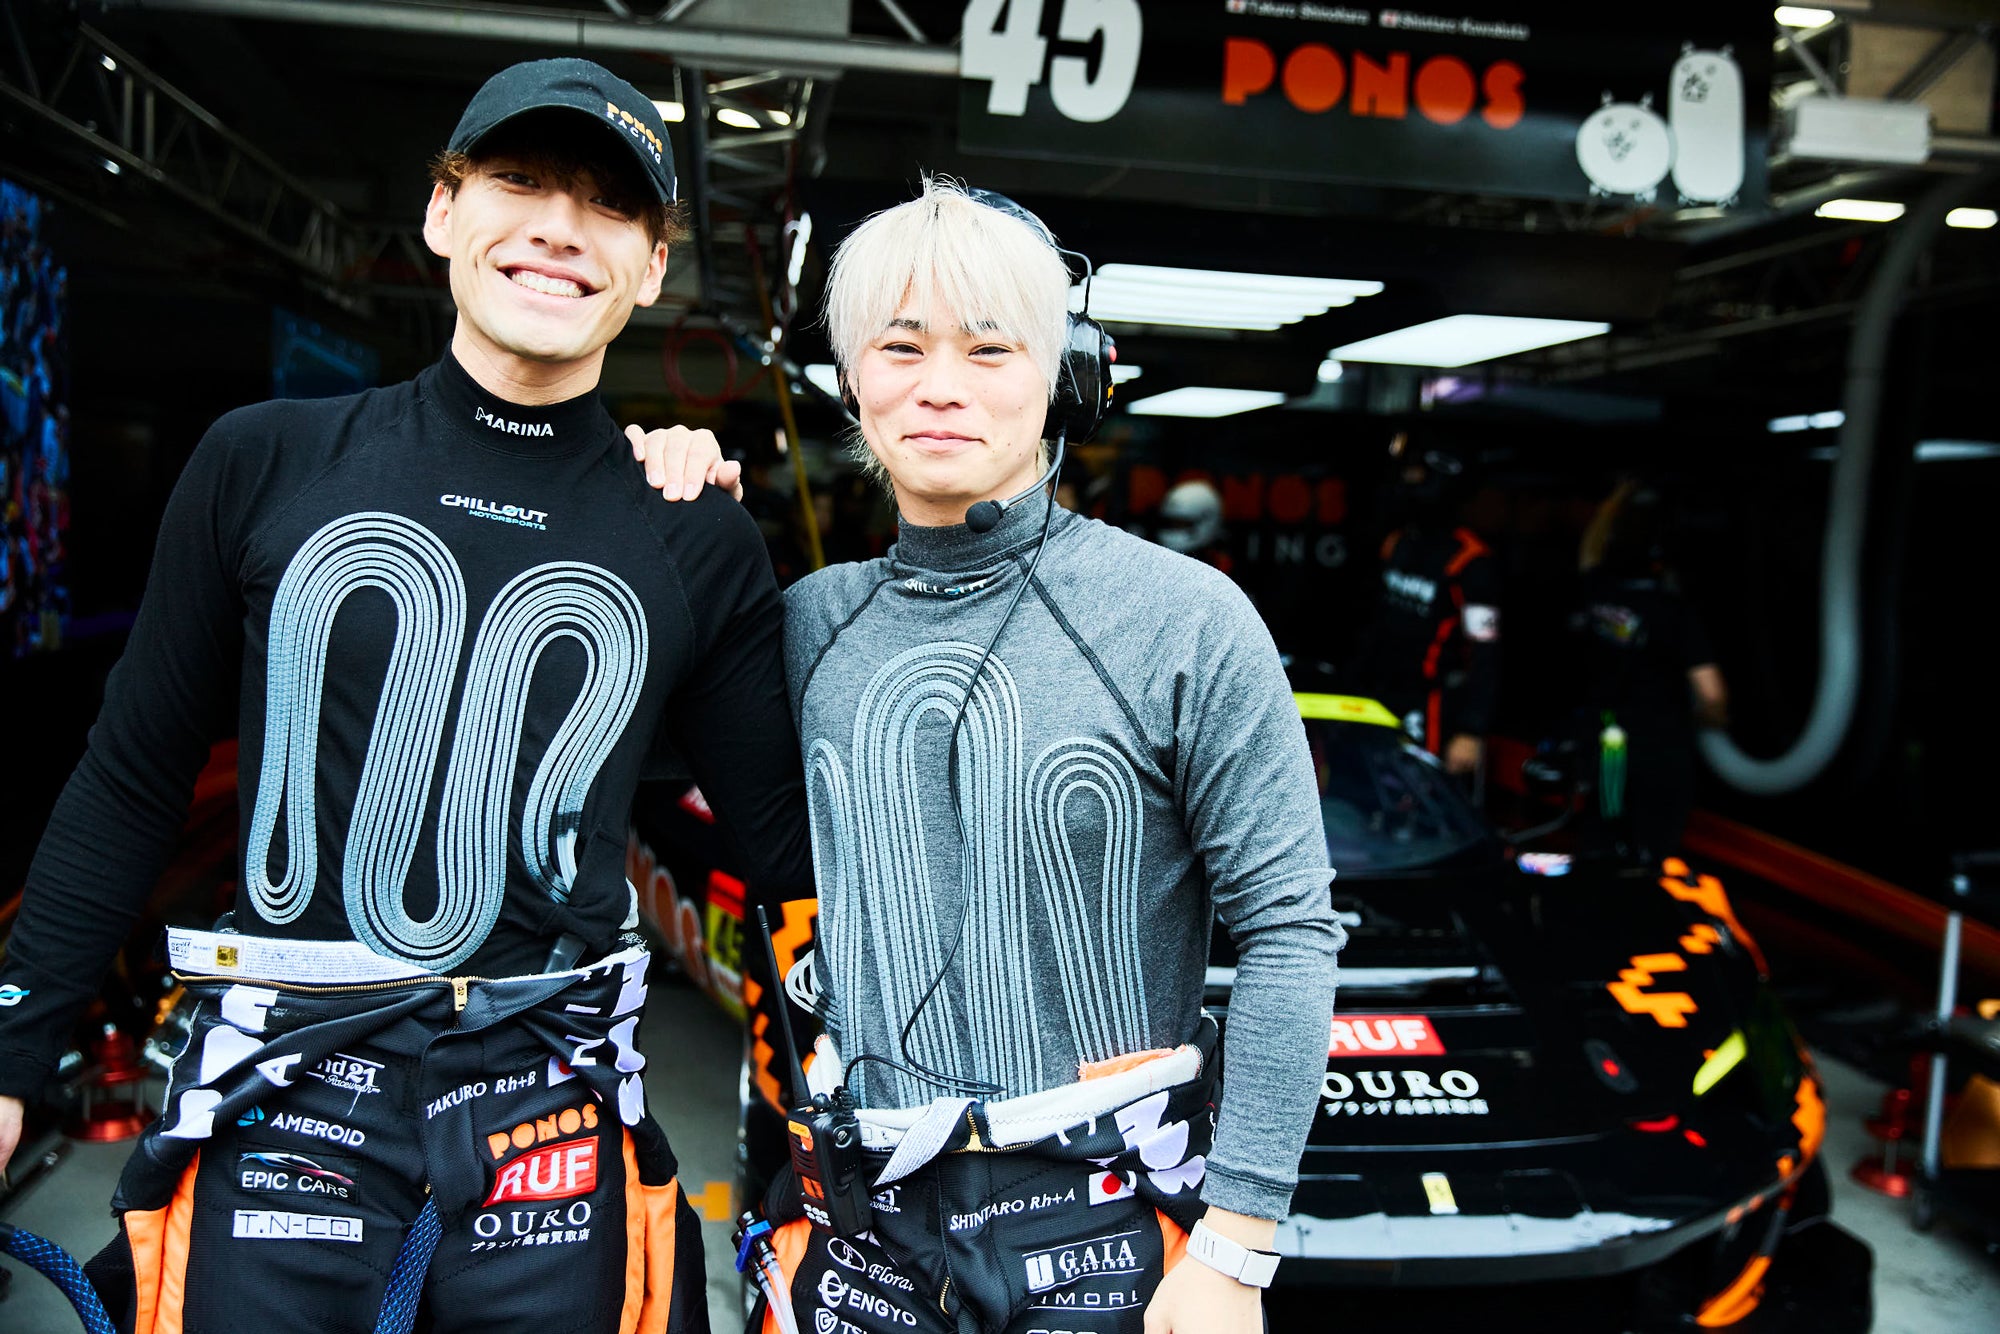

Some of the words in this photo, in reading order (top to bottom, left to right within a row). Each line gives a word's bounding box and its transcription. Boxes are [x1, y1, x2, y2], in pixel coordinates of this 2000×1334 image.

[961, 0, 1143, 122] 45
[1221, 36, 1527, 130] PONOS
[605, 111, 661, 165] RACING
[606, 101, 663, 153] PONOS
[475, 407, 555, 437] MARINA
[440, 494, 548, 524] CHILLOUT
[468, 509, 547, 531] MOTORSPORTS
[1328, 1019, 1428, 1051] RUF
[426, 1081, 488, 1120] TAKURO
[494, 1070, 538, 1094] Rh+B
[1320, 1069, 1480, 1100] OURO
[269, 1111, 366, 1148] AMEROID
[487, 1103, 599, 1160] PONOS
[241, 1170, 289, 1190] EPIC
[296, 1175, 349, 1199] CARS
[492, 1145, 594, 1202] RUF
[473, 1200, 592, 1238] OURO
[949, 1198, 1025, 1231] SHINTARO
[1058, 1239, 1138, 1273] GAIA
[847, 1288, 918, 1327] ENGYO
